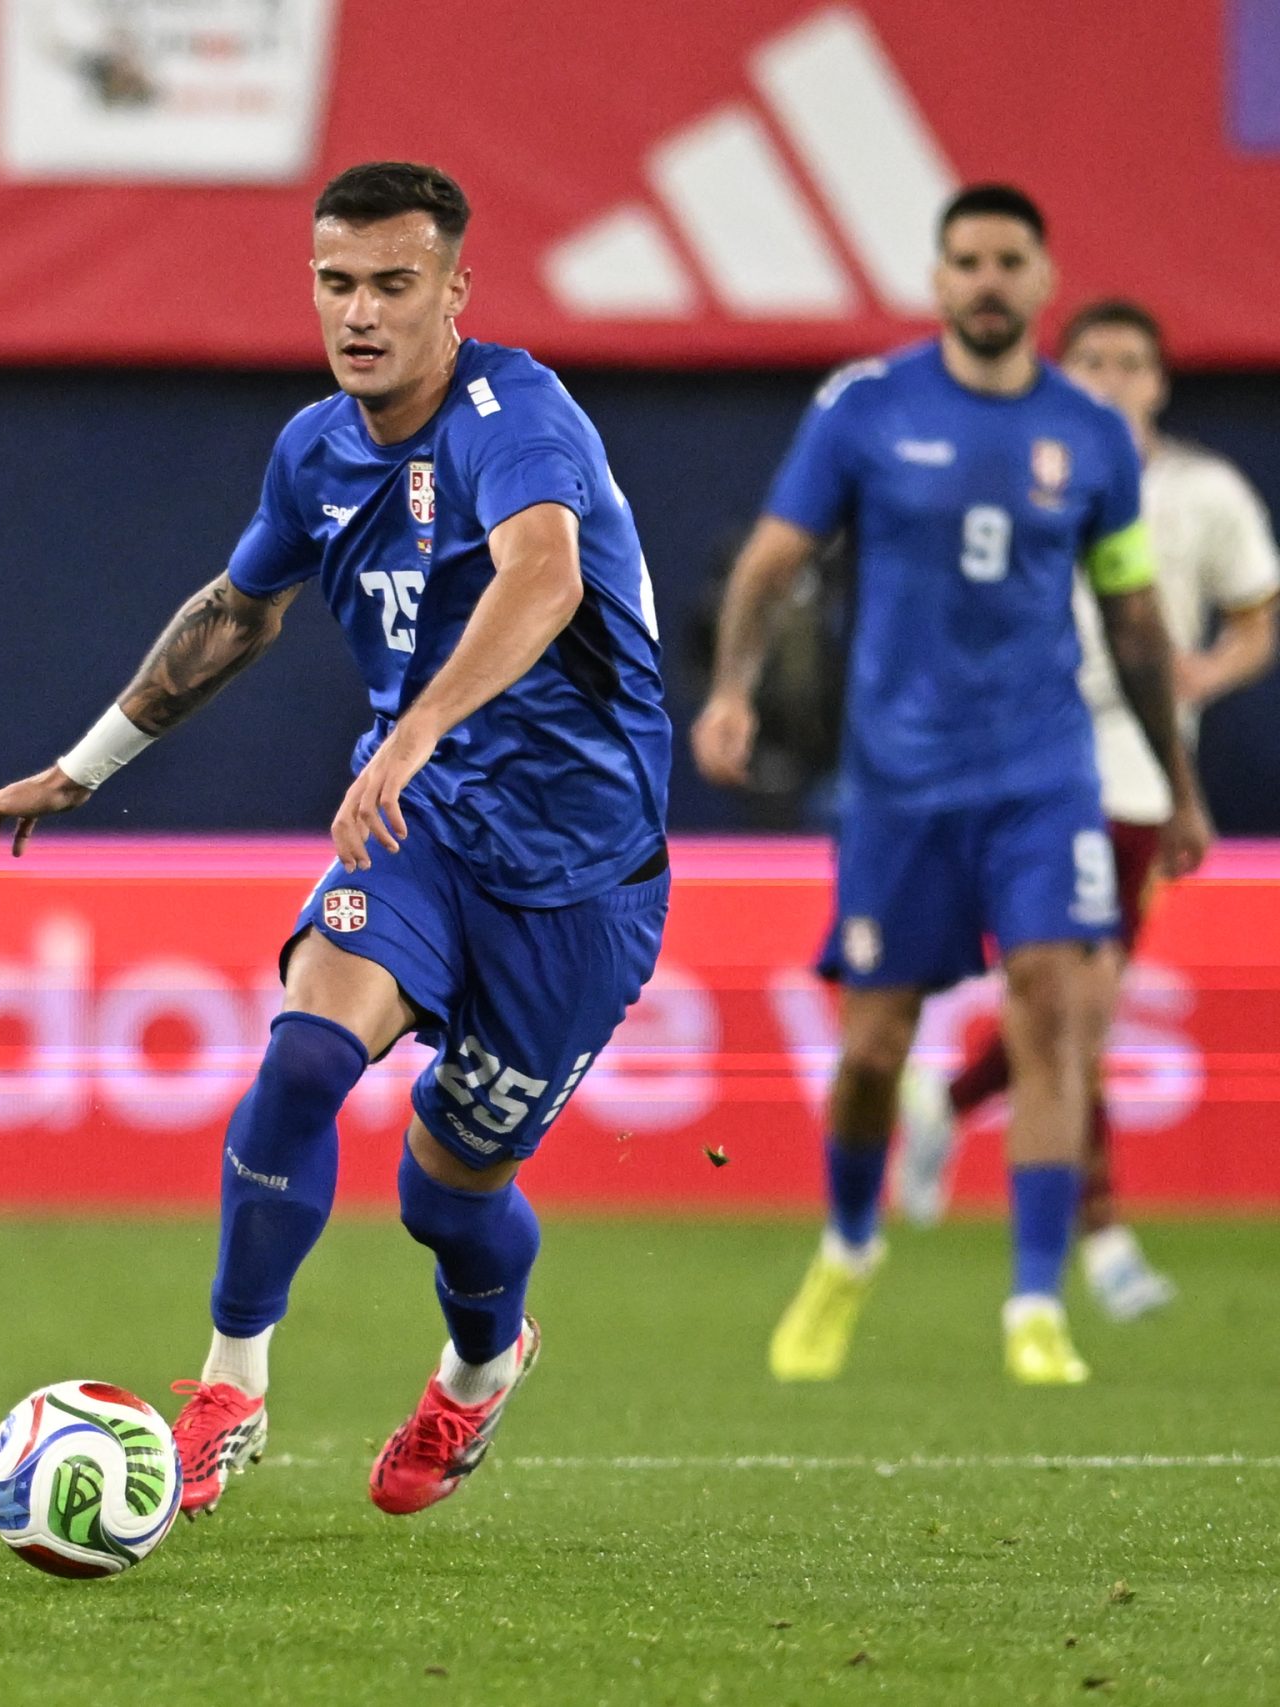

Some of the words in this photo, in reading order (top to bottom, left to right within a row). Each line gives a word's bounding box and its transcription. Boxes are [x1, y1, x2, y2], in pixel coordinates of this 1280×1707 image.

[961, 505, 1012, 581] 9
[1073, 830, 1117, 899] 9
[434, 1034, 549, 1134] 25
